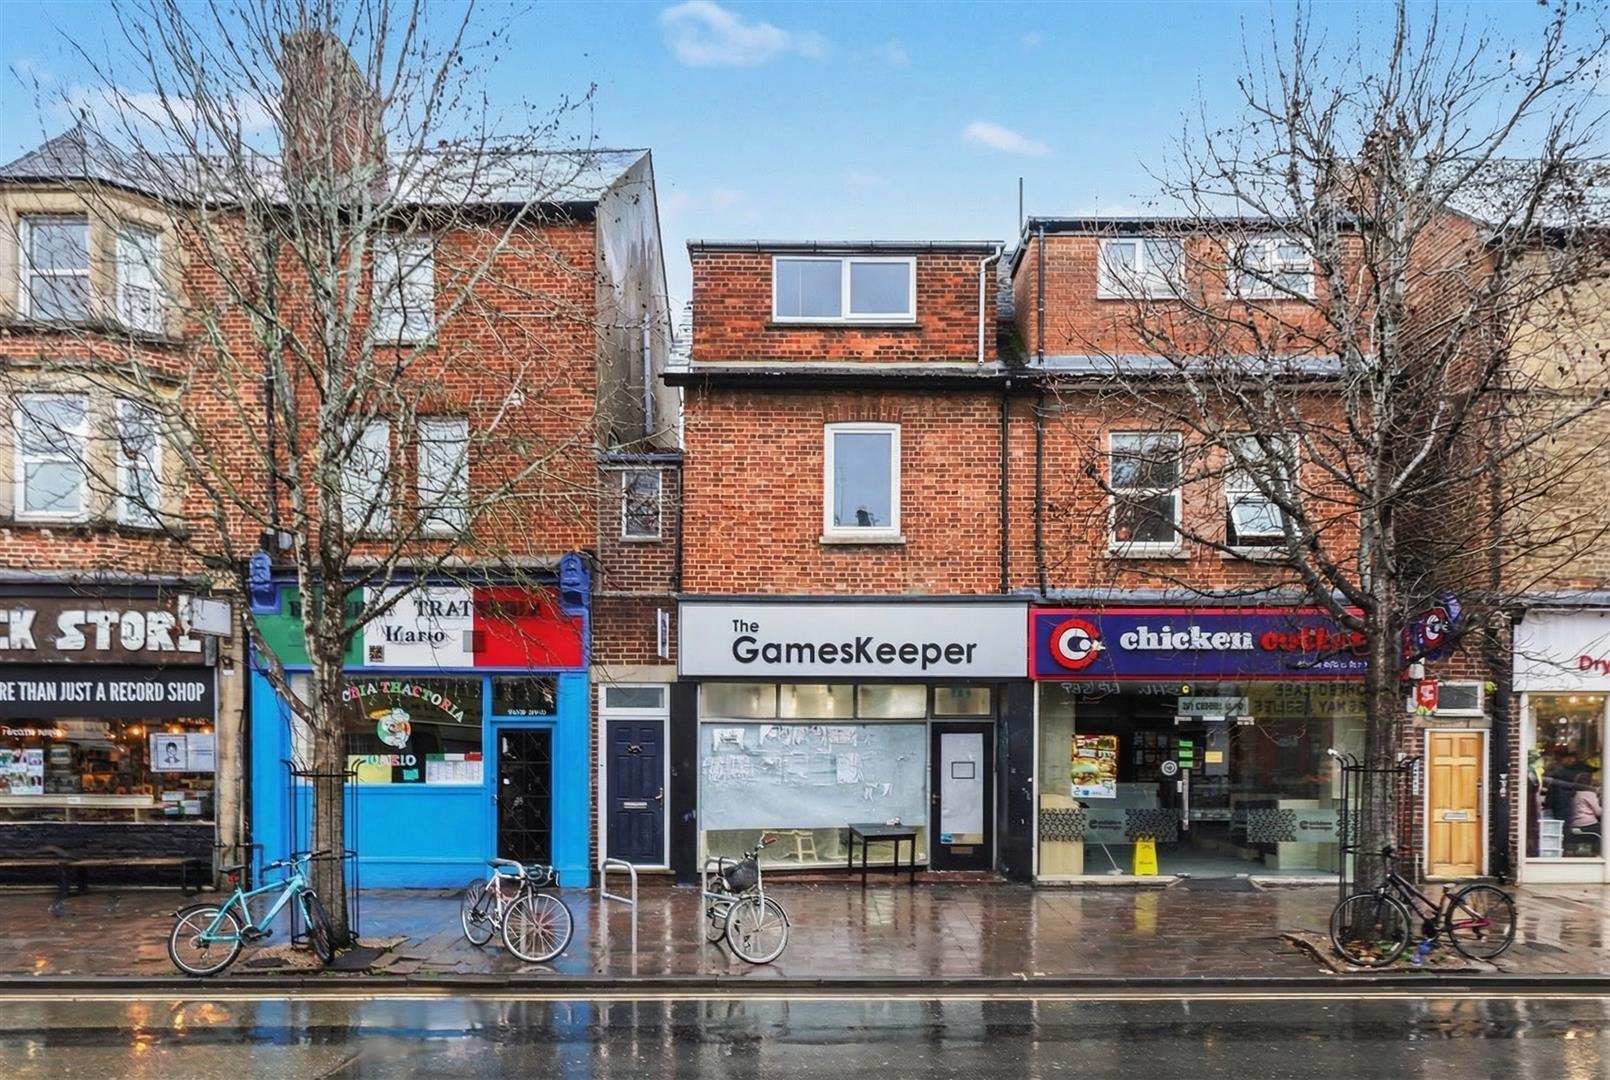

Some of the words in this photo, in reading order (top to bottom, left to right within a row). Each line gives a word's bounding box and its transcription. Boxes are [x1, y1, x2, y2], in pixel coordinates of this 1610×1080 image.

[733, 619, 760, 632] The
[1120, 625, 1255, 650] chicken
[733, 635, 977, 670] GamesKeeper
[18, 682, 57, 701] THAN
[60, 682, 93, 701] JUST
[96, 682, 106, 701] A
[110, 682, 164, 701] RECORD
[168, 682, 205, 701] SHOP
